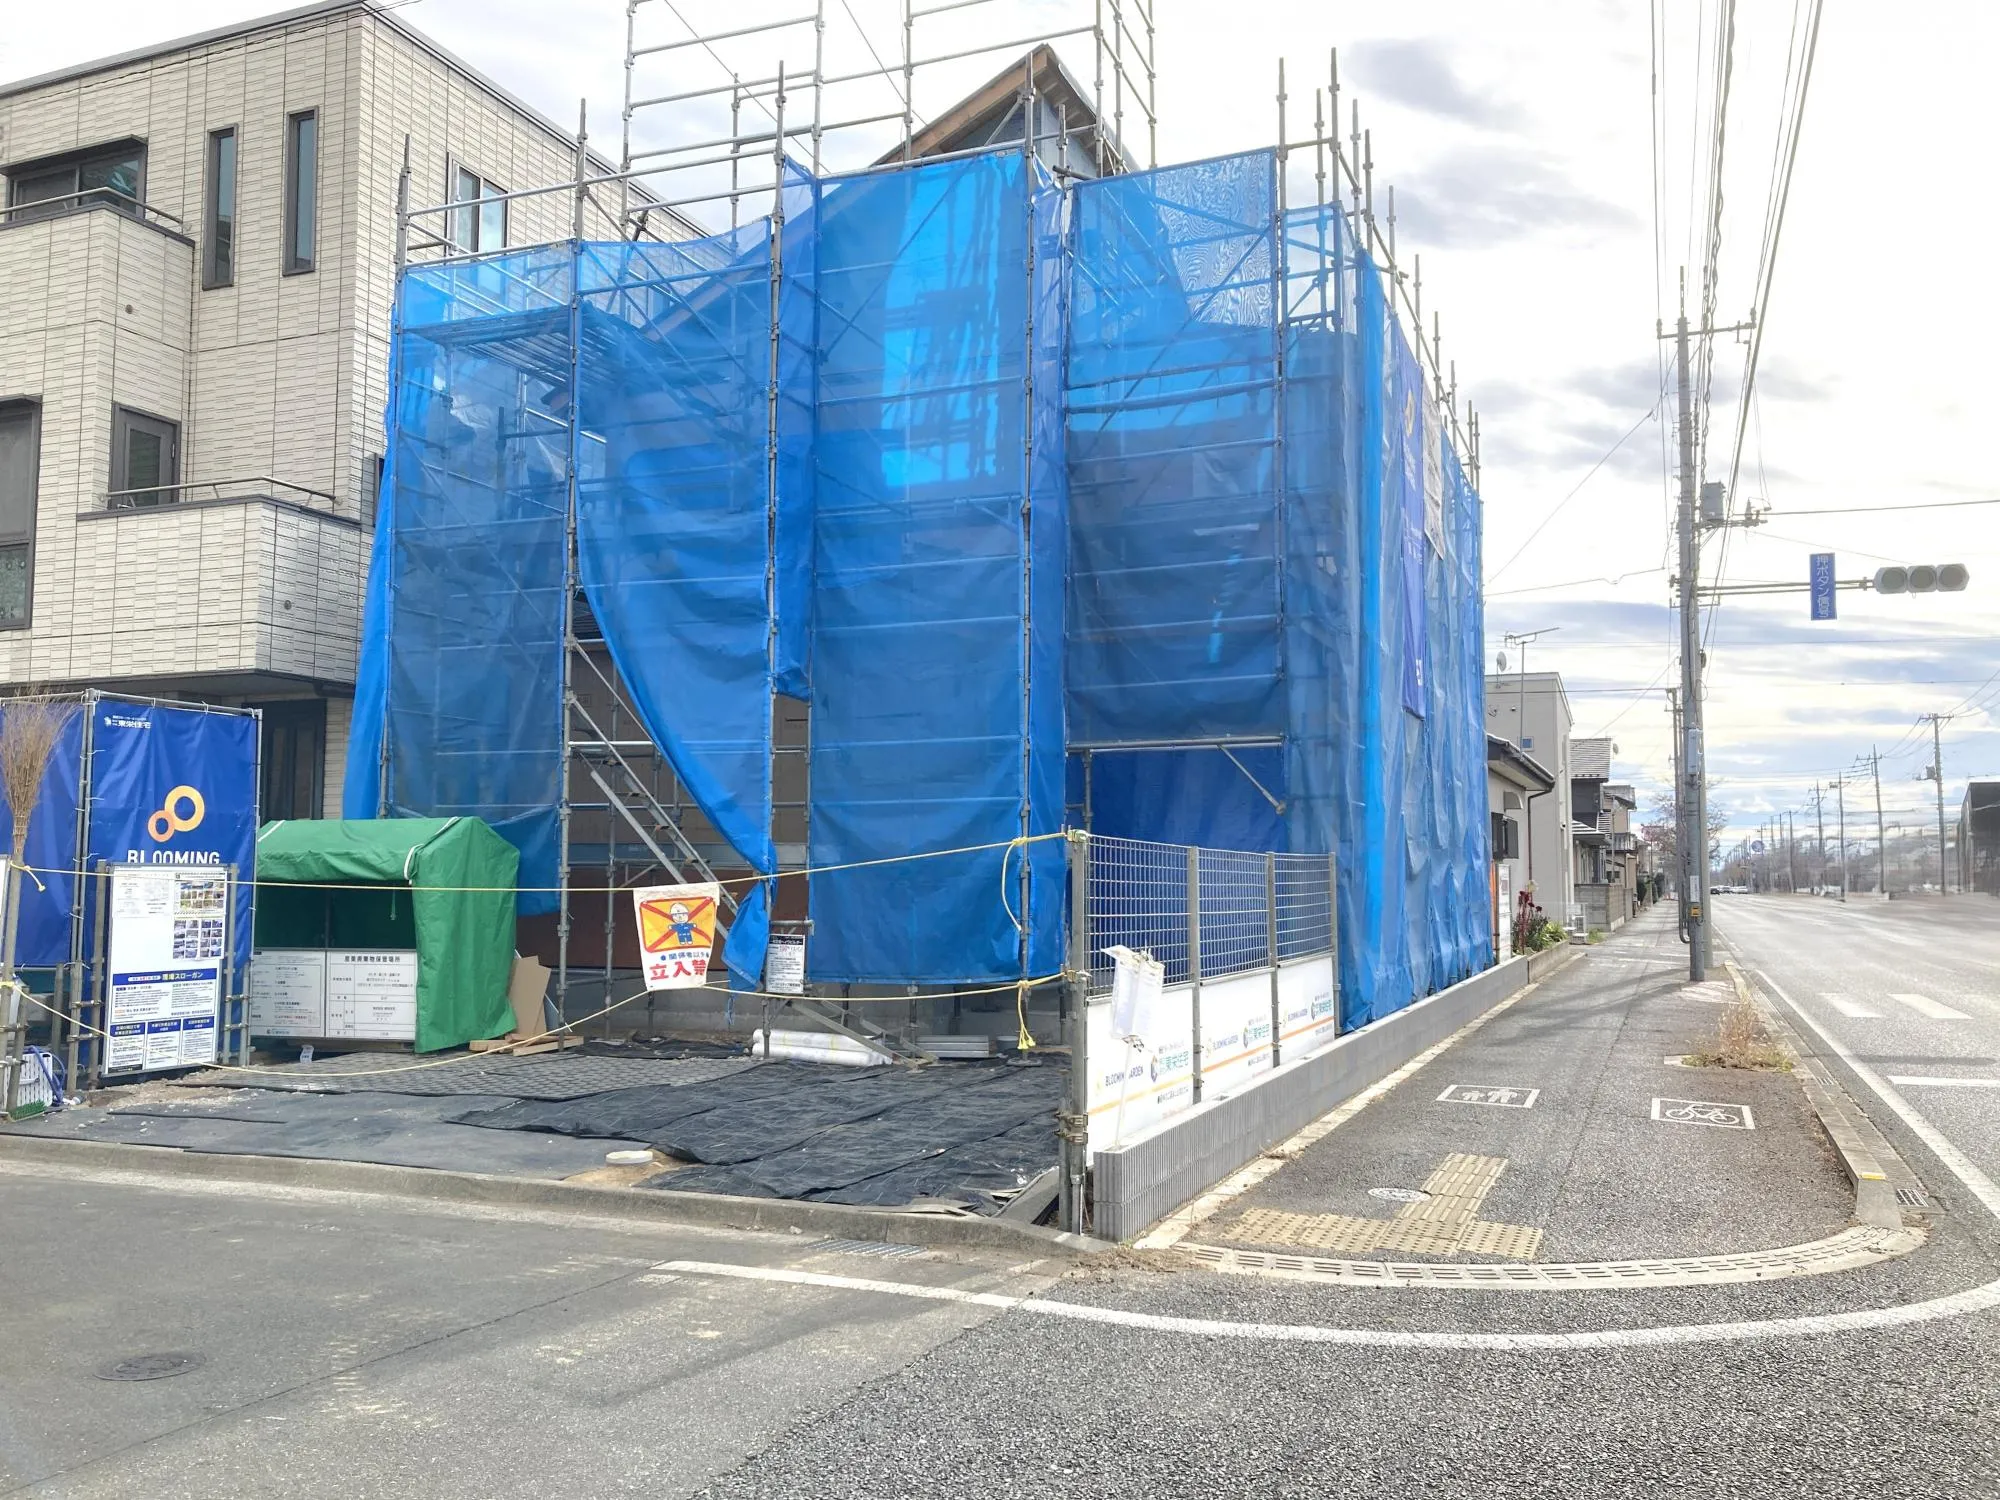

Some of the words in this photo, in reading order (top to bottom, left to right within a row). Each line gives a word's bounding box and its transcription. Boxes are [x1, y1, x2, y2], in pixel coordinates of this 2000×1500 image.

[127, 849, 220, 864] BLOOMING
[1105, 1072, 1125, 1087] BLOOMIN
[1129, 1065, 1144, 1079] ARDEN
